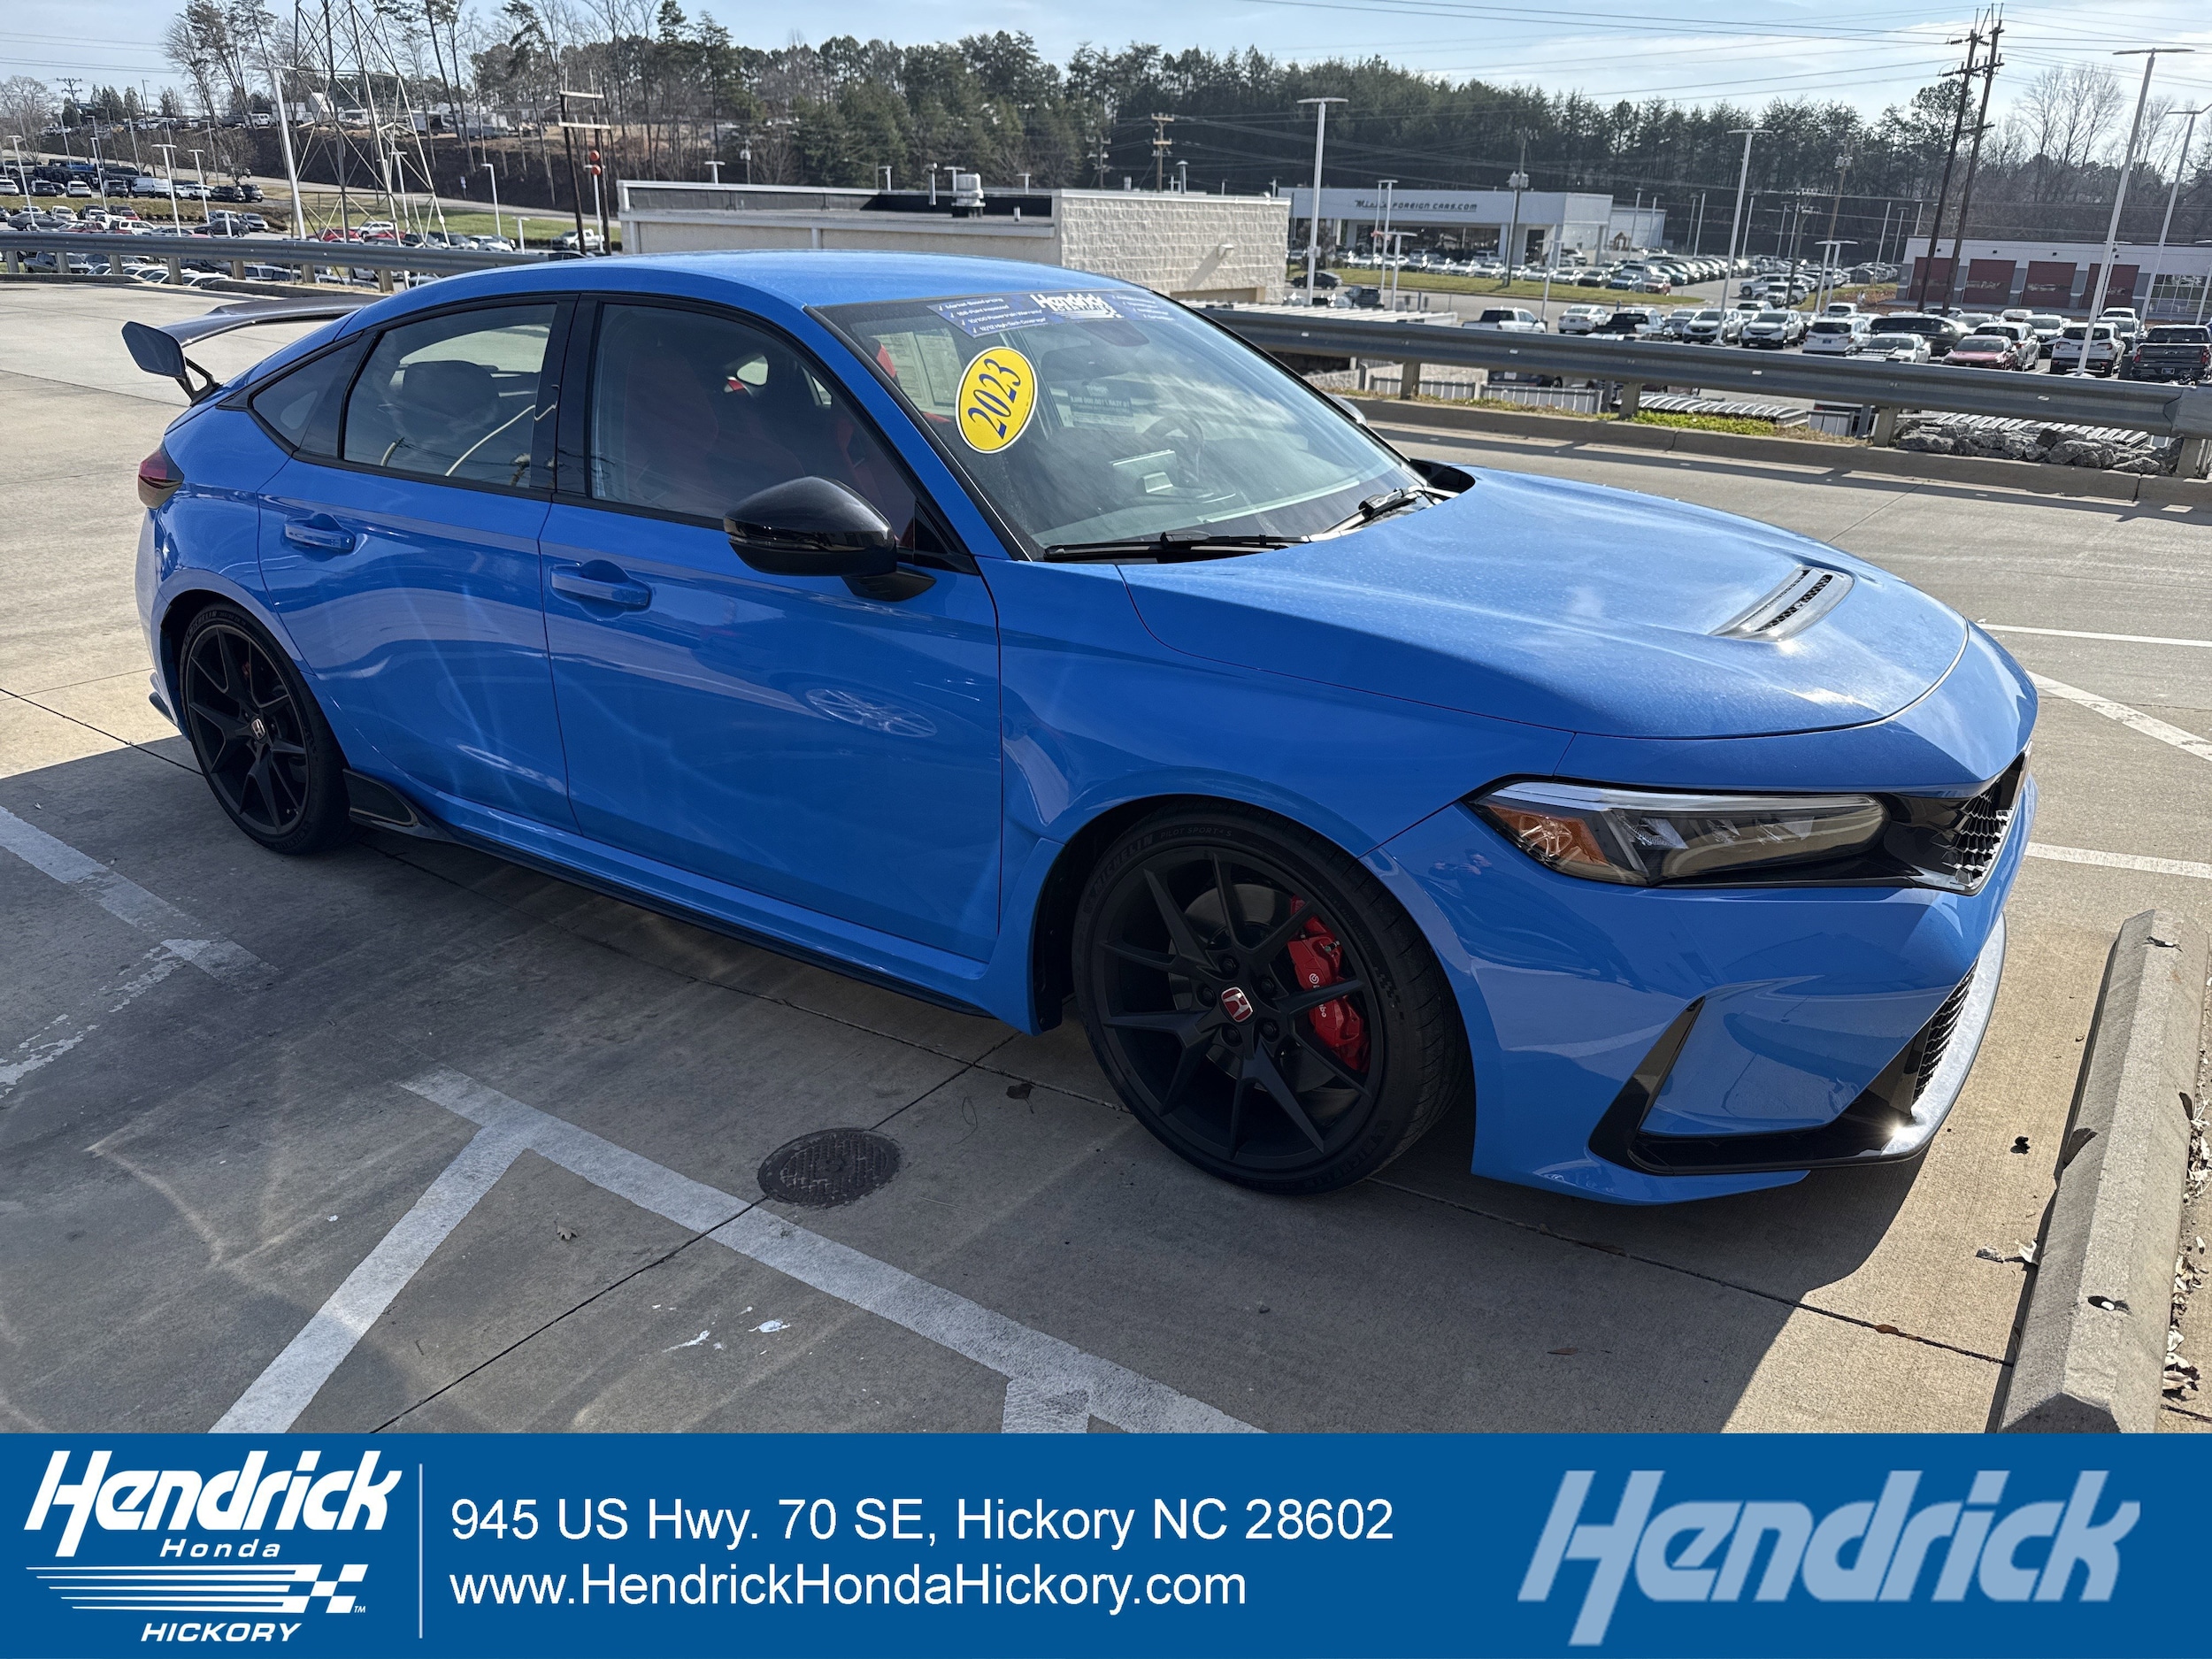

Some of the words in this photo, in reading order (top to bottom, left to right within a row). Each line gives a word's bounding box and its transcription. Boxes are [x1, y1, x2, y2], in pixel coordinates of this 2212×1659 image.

[1030, 293, 1107, 311] Hendrick
[967, 357, 1021, 440] 2023
[1094, 833, 1153, 895] MICHELIN
[1160, 827, 1186, 840] PILOT
